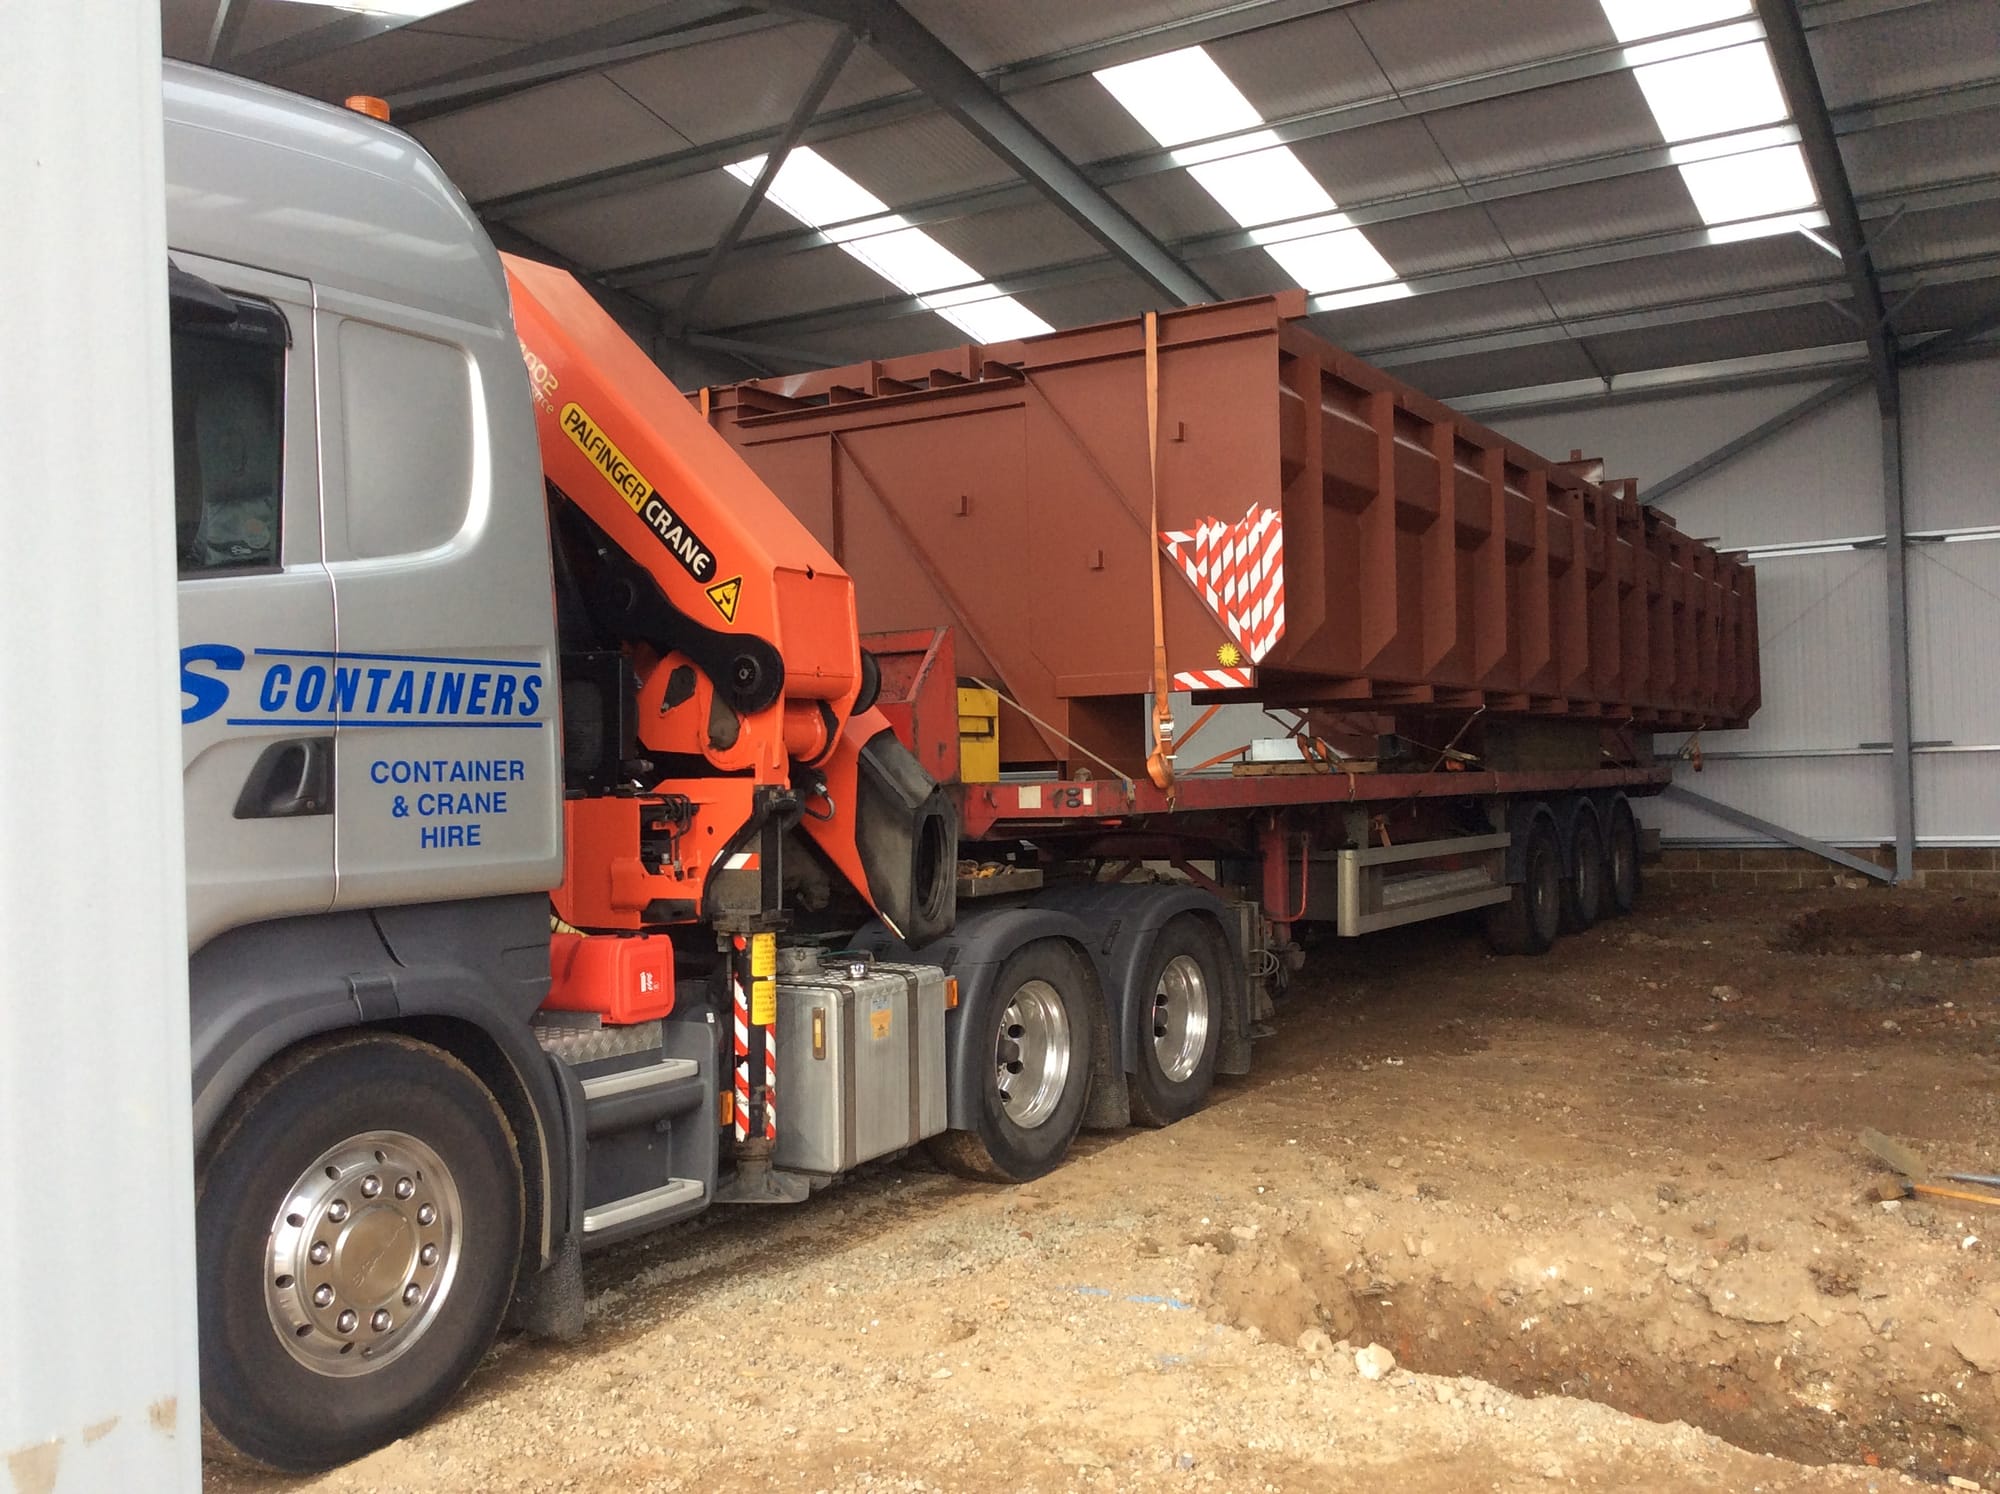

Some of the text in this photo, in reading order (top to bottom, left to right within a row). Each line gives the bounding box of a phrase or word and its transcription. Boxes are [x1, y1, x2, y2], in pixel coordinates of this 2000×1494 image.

[564, 408, 710, 576] PALFINGER CRANE
[180, 643, 245, 724] S
[260, 664, 543, 717] CONTAINERS
[370, 760, 525, 784] CONTAINER
[391, 792, 508, 818] & CRANE
[421, 825, 481, 849] HIRE
